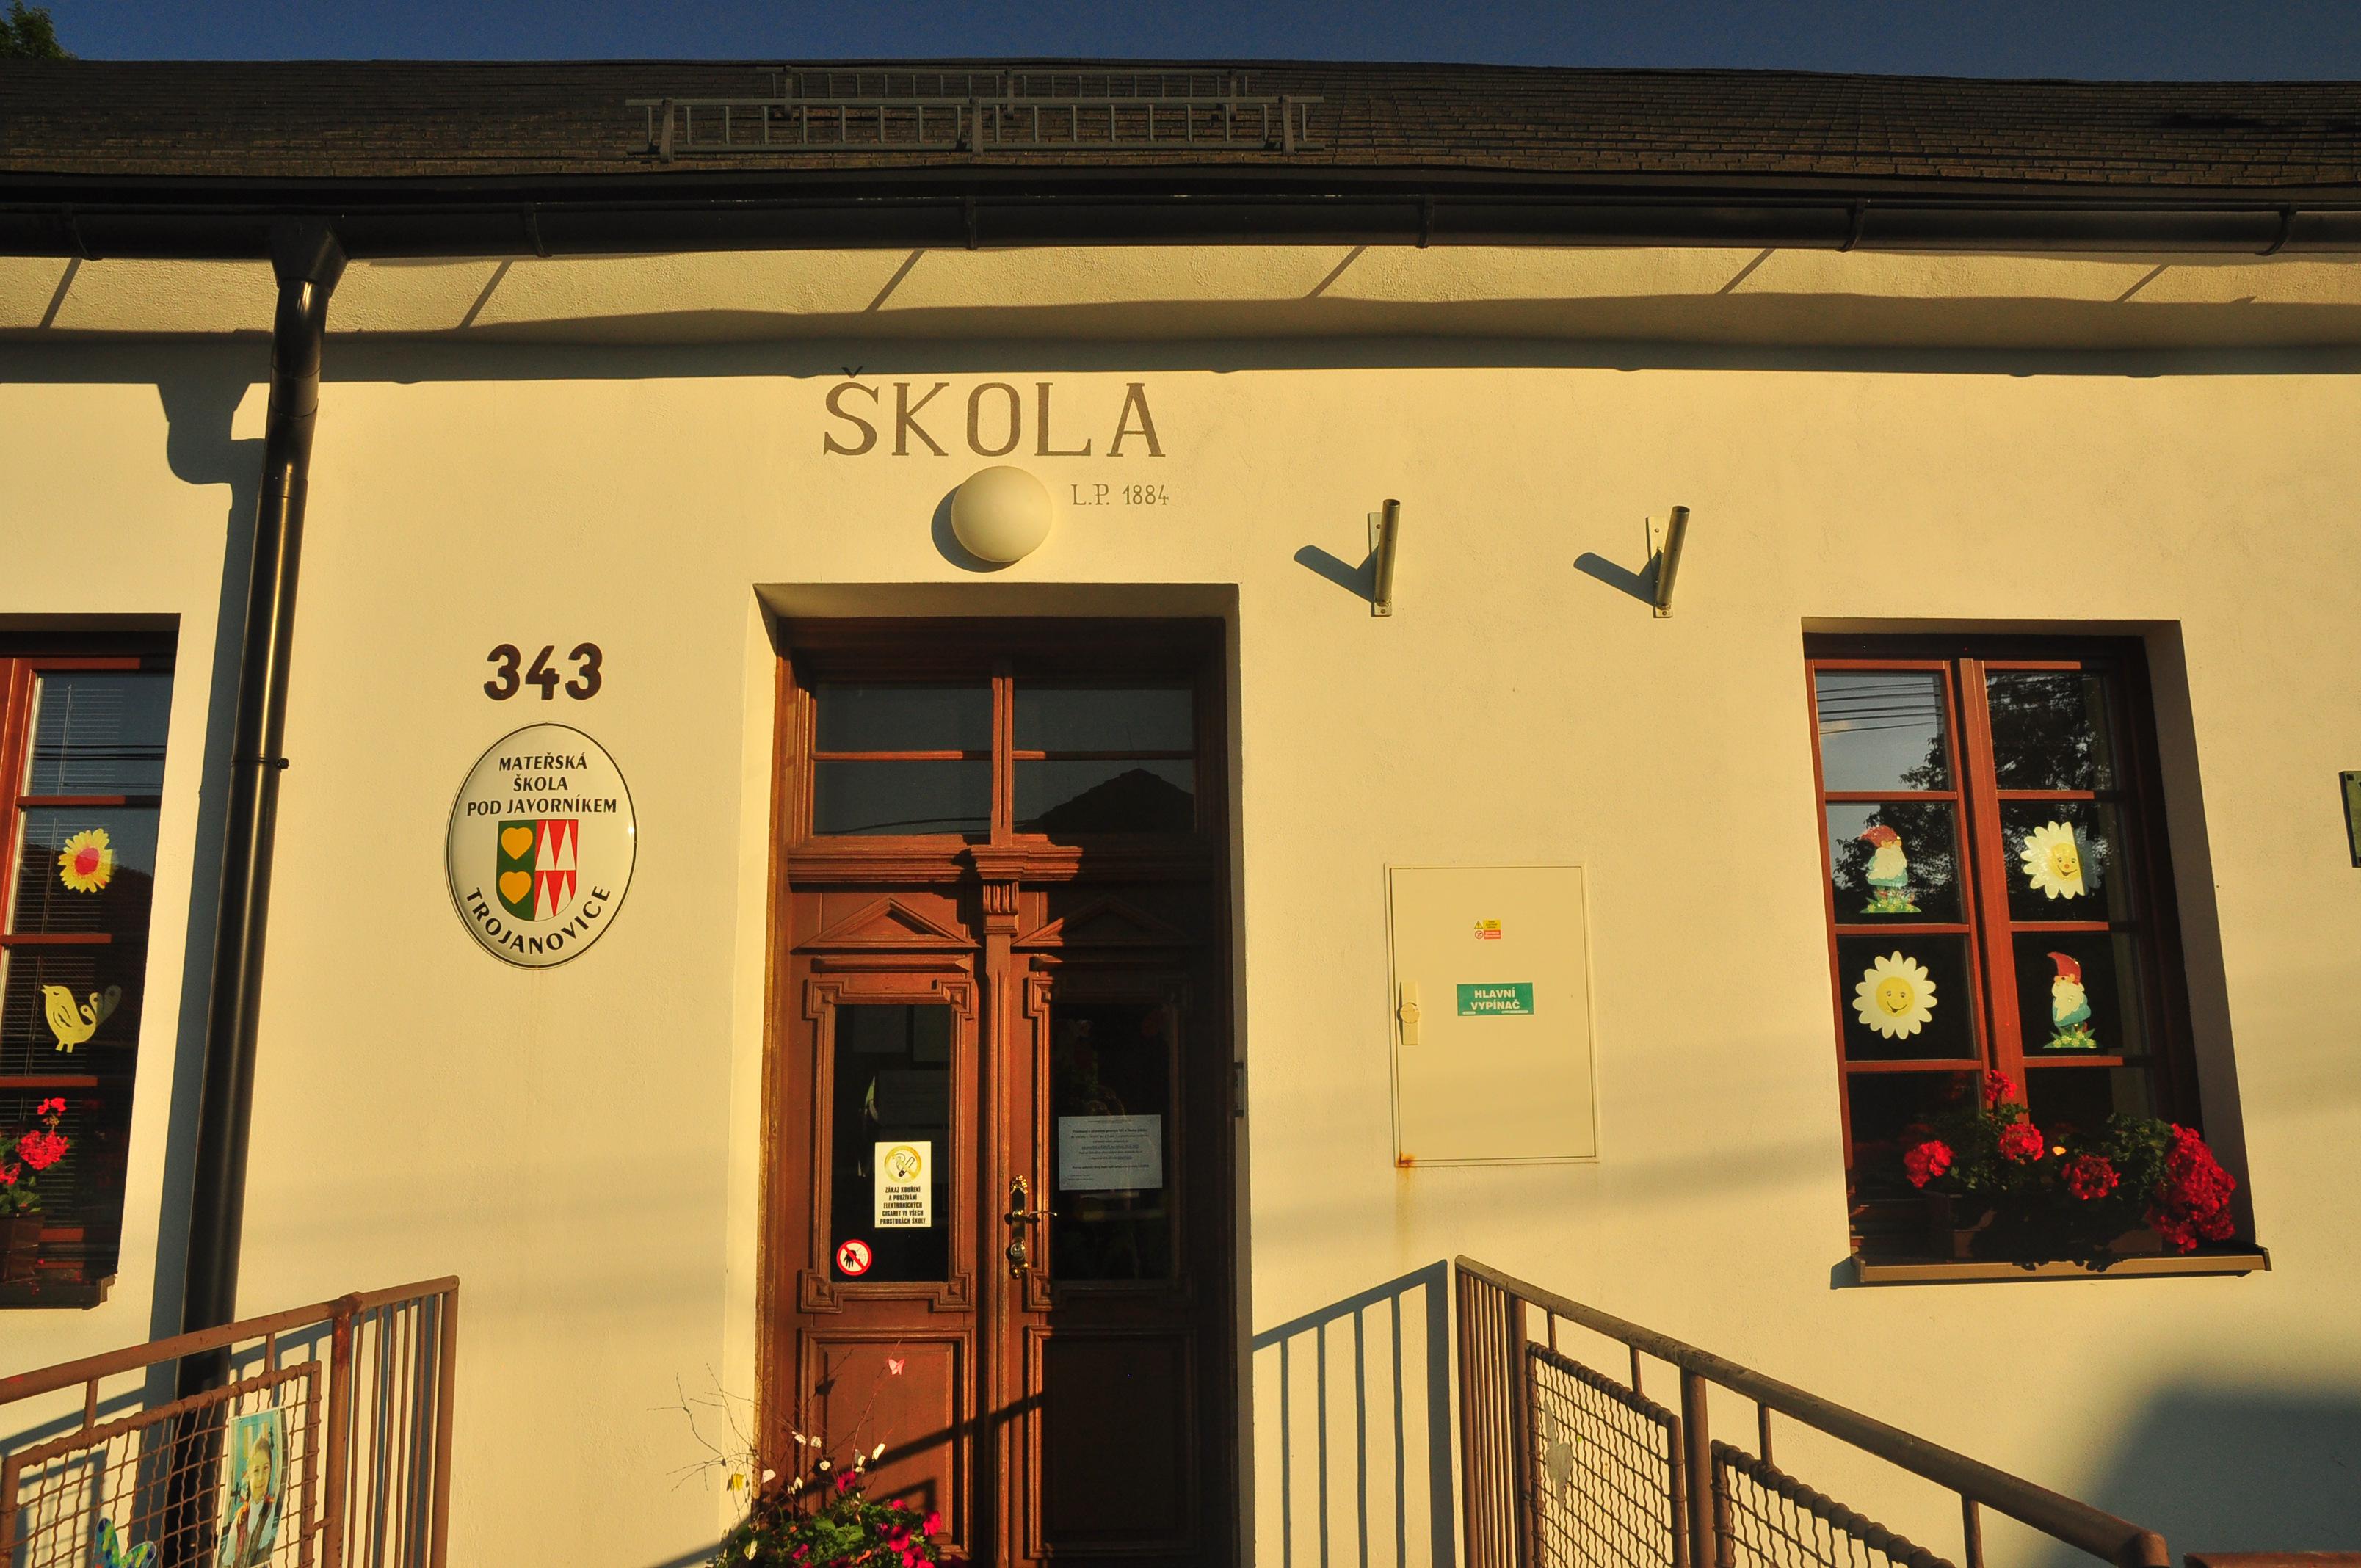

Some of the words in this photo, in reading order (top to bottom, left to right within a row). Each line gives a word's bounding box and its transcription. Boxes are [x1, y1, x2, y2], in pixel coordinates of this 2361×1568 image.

[823, 366, 1166, 457] ŠKOLA
[1071, 484, 1110, 506] L.P.
[1122, 484, 1169, 505] 1884
[483, 642, 603, 701] 343
[498, 752, 588, 772] MATEŘSKÁ
[513, 774, 568, 792] ŠKOLA
[467, 800, 501, 816] POD
[507, 794, 617, 814] JAVORNÍKEM
[466, 885, 611, 954] TROJANOVICE
[1474, 987, 1515, 998] HLAVNÍ
[1470, 999, 1520, 1010] VYPÍNAČ
